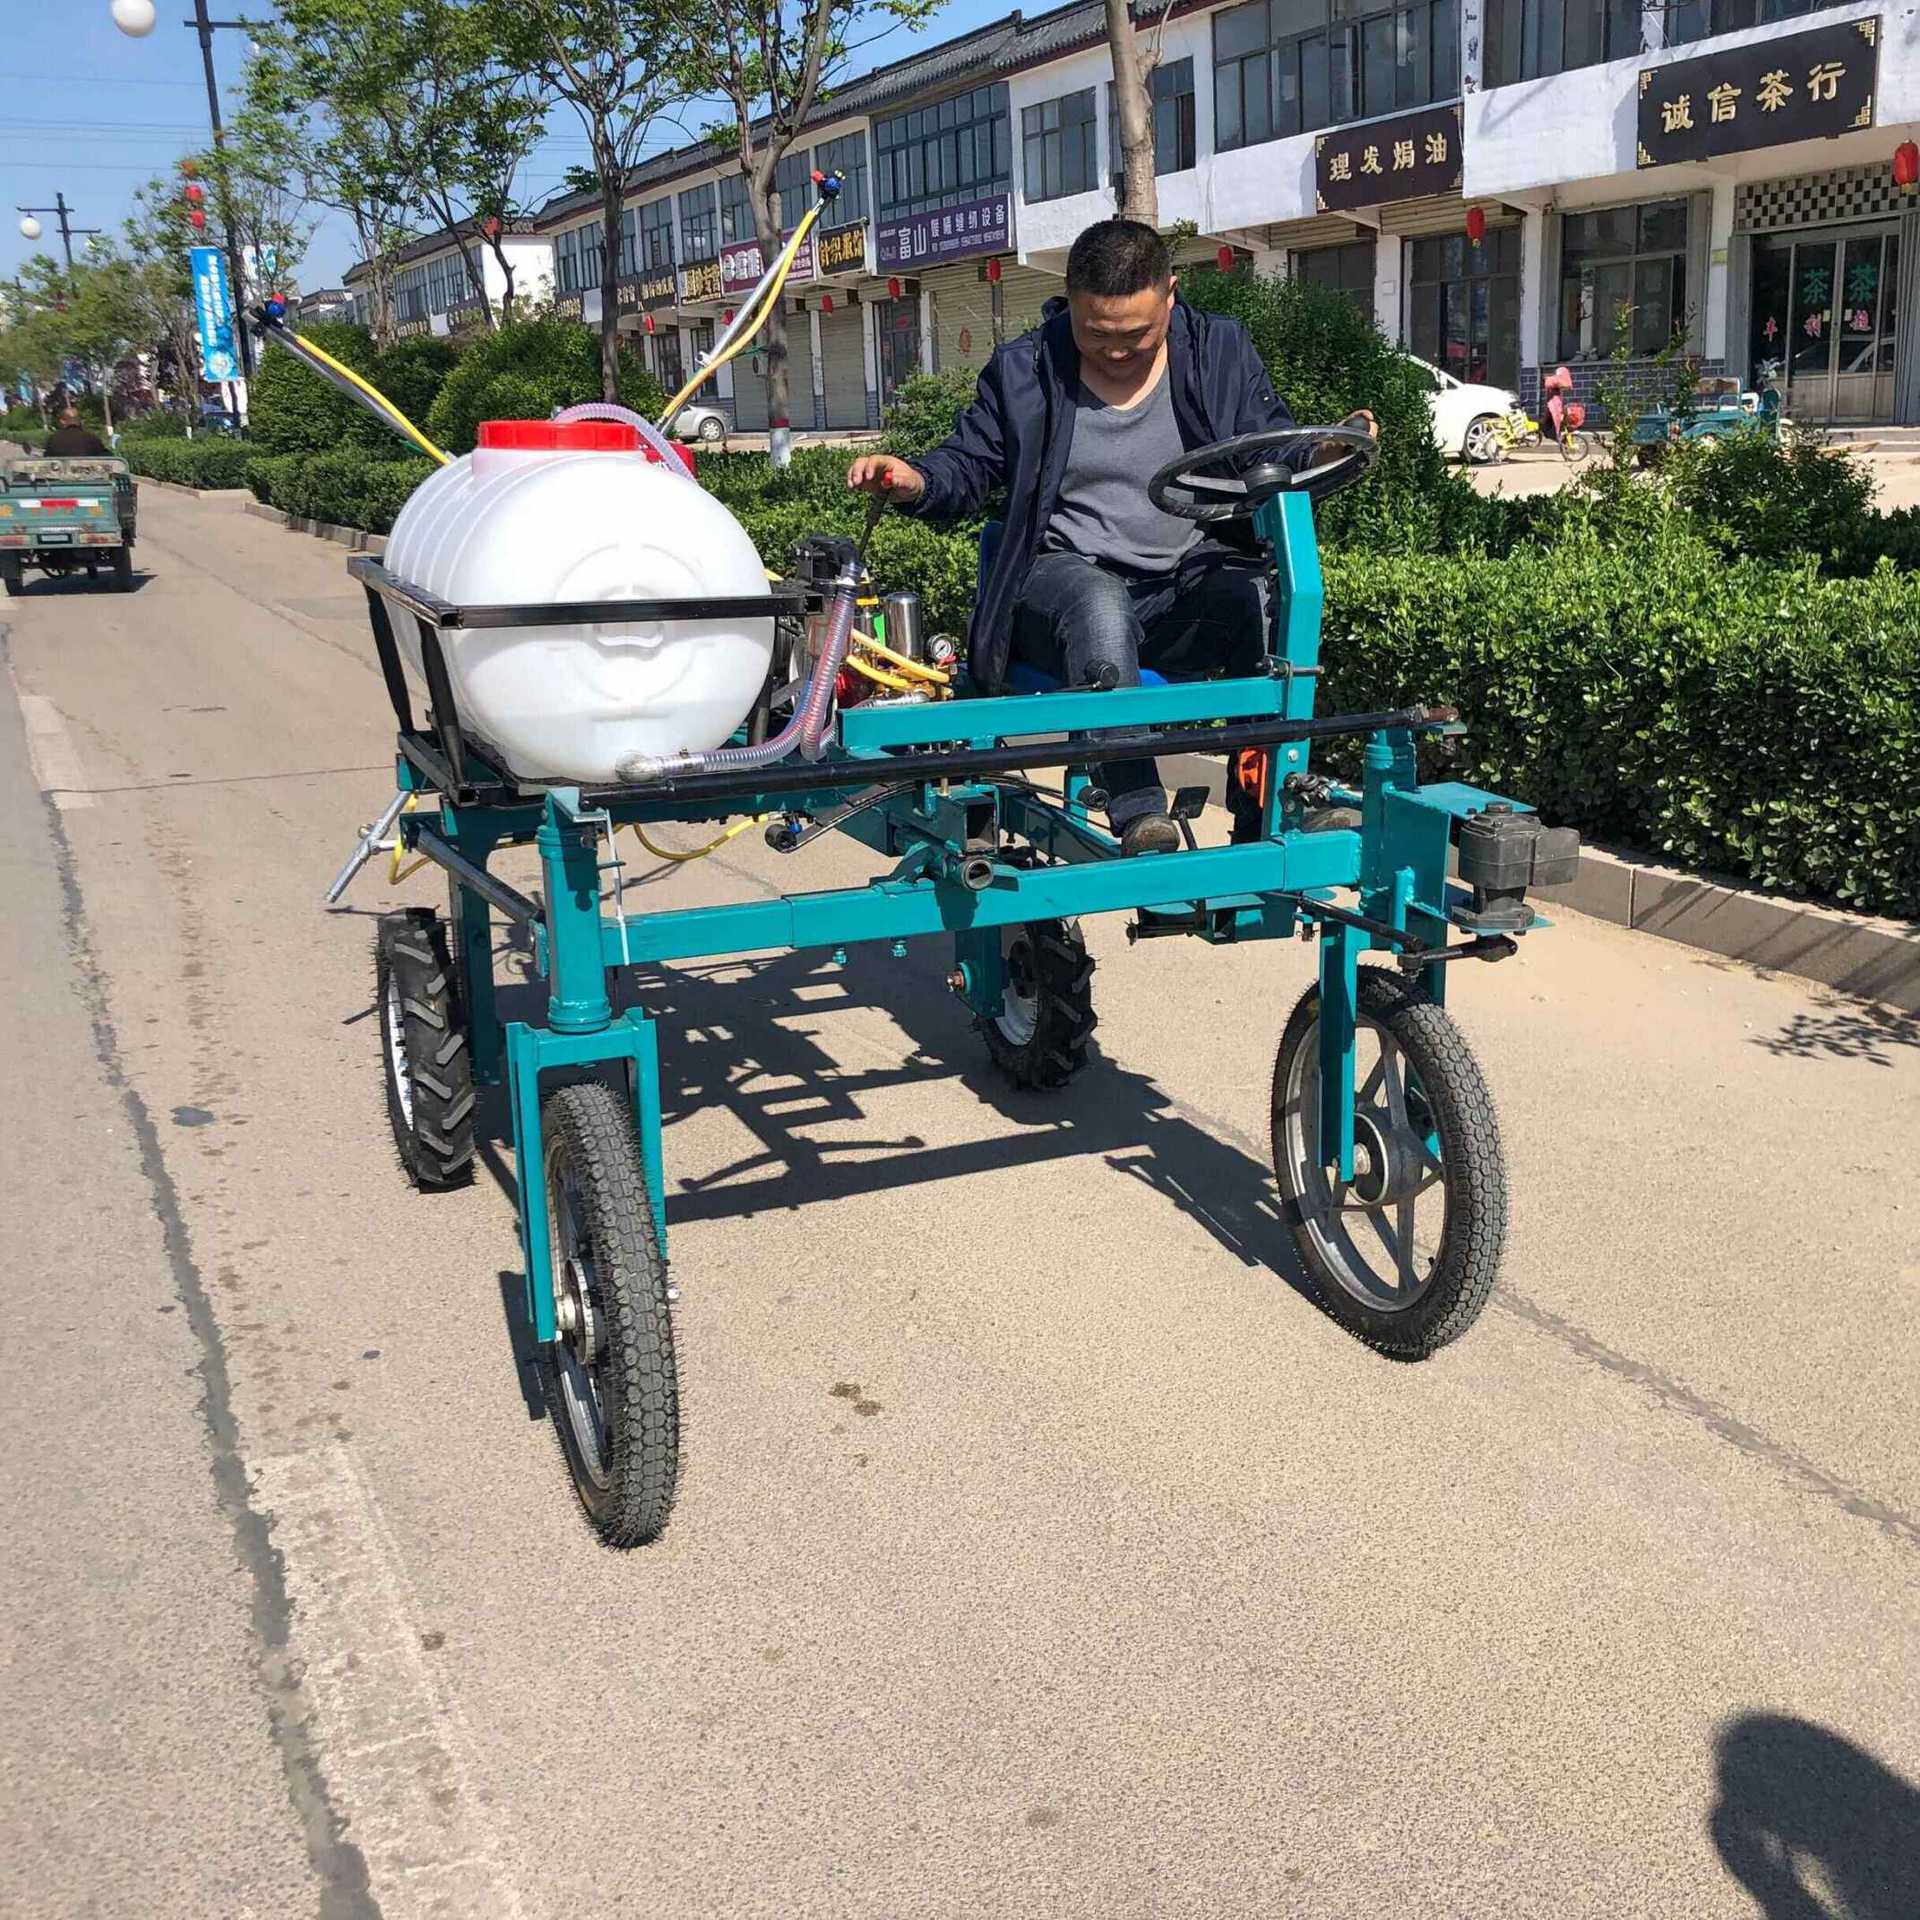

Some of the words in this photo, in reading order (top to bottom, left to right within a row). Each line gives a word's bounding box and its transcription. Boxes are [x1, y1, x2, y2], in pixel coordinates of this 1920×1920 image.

[1661, 61, 1847, 134] 诚信茶行
[1329, 132, 1448, 182] 理发焗油
[1803, 268, 1830, 304] 茶
[1848, 264, 1877, 303] 茶
